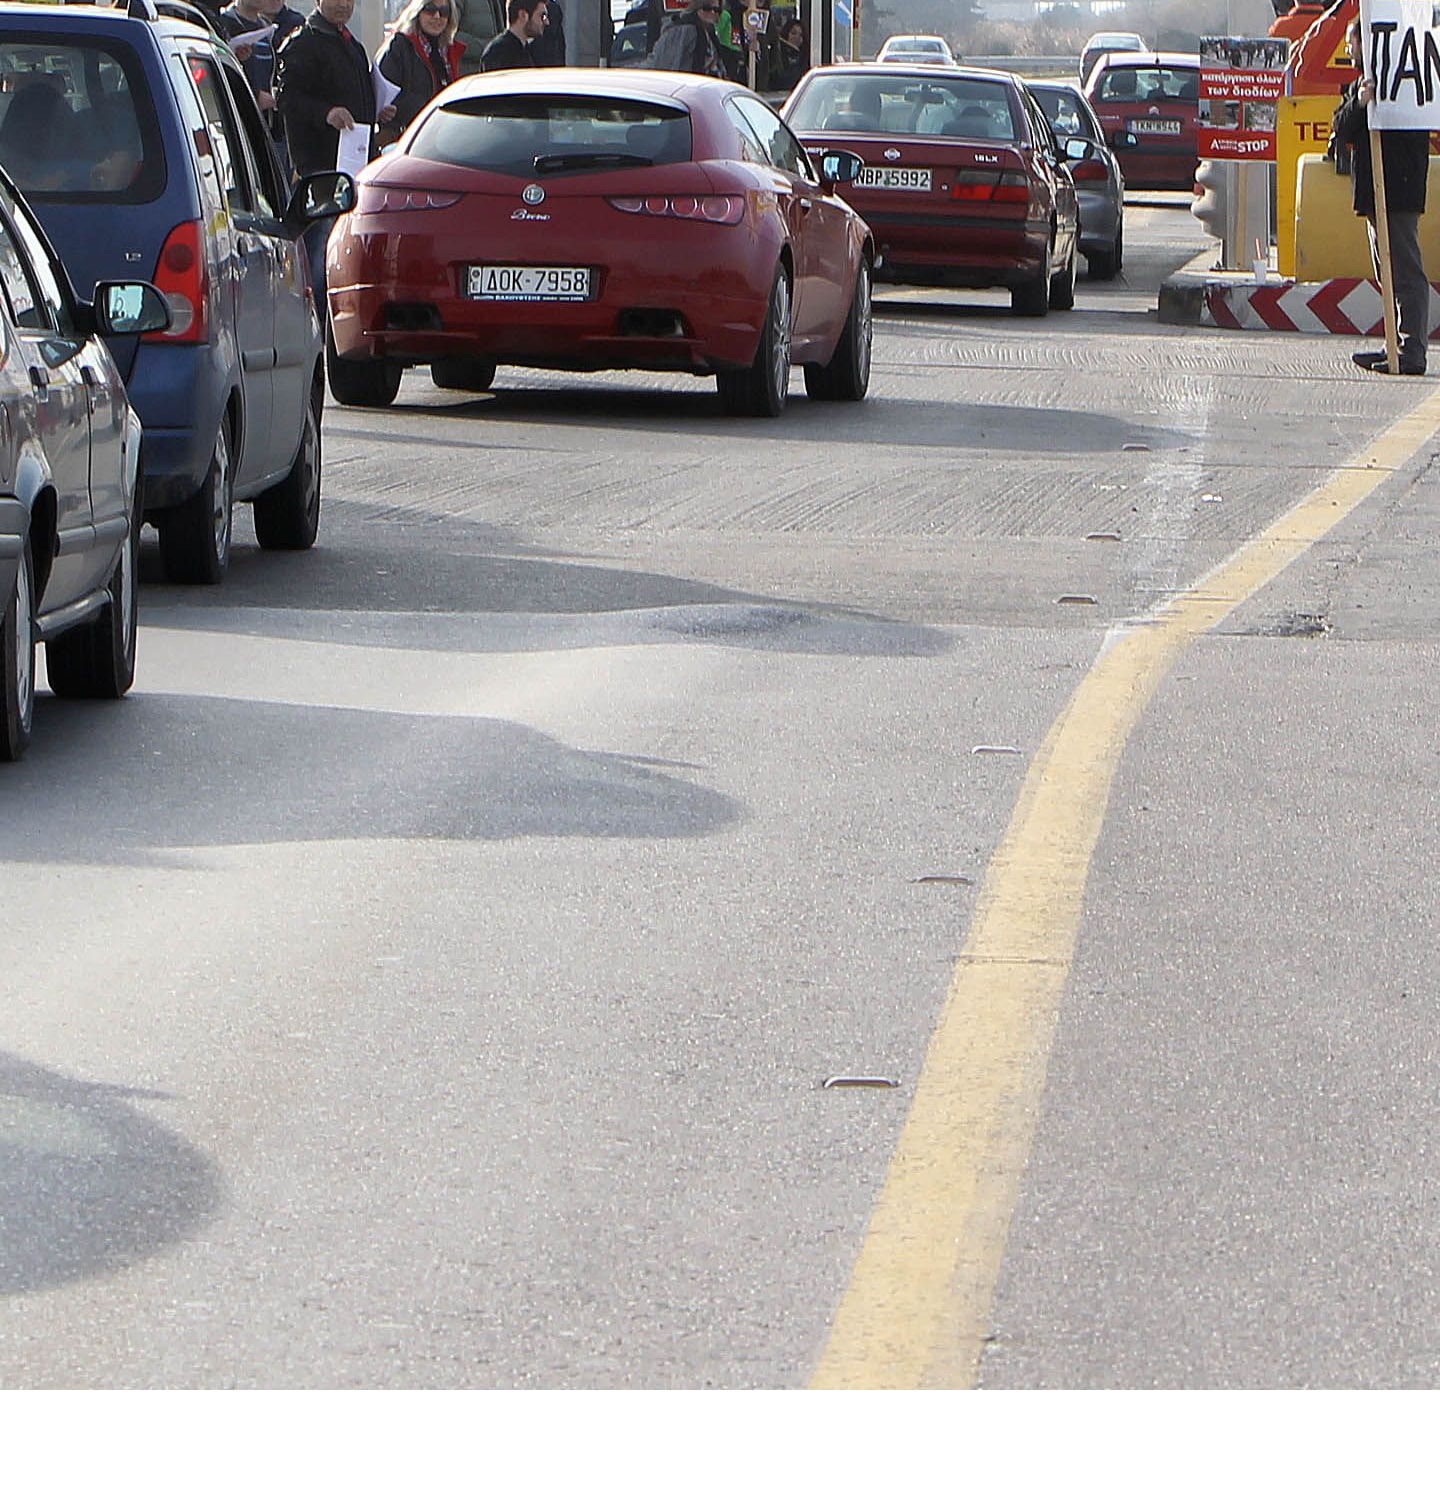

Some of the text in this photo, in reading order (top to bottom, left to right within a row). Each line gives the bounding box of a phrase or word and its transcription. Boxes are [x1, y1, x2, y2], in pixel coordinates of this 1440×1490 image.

[1201, 72, 1283, 85] κατάργηση όλων
[1207, 85, 1280, 97] των διοδίων
[1237, 139, 1269, 153] STOP
